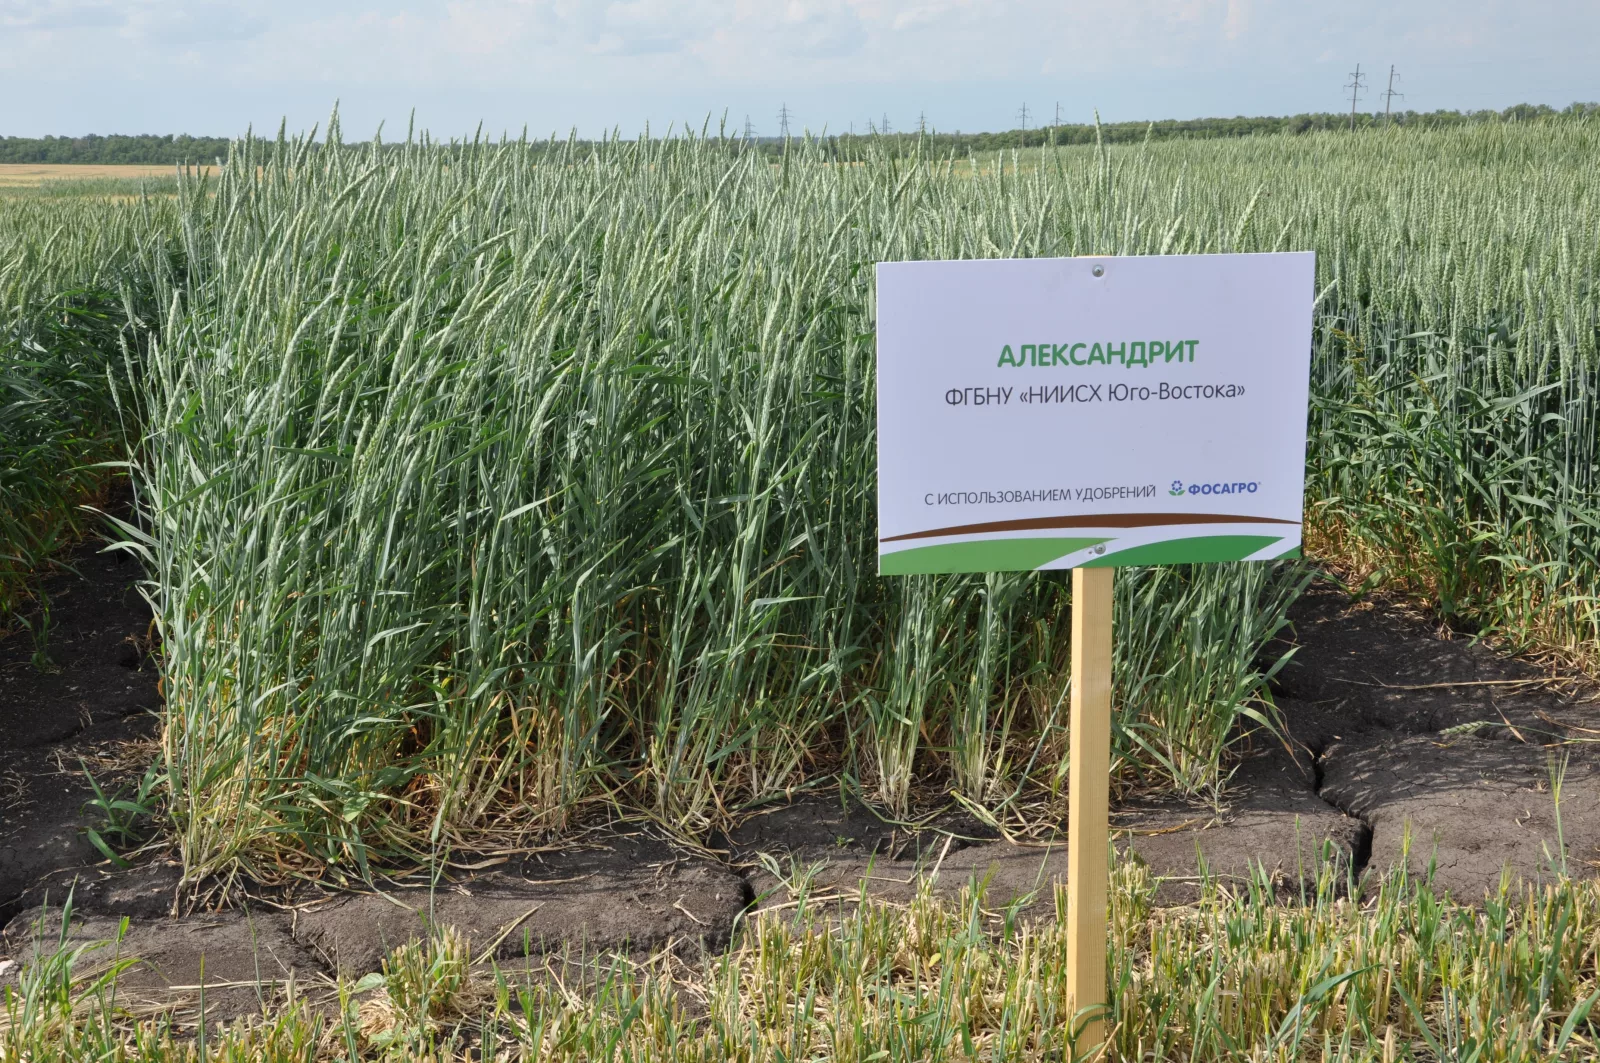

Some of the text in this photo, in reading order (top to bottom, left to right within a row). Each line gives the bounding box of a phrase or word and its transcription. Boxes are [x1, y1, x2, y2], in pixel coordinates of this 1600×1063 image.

[996, 339, 1200, 370] АЛЕКСАНДРИТ
[944, 381, 1246, 407] ФГБНУ «НИИСХ Юго-Востока»
[924, 484, 1156, 506] С ИСПОЛЬЗОВАНИЕМ УДОБРЕНИЙ
[1187, 481, 1258, 496] ФОСАГРО
